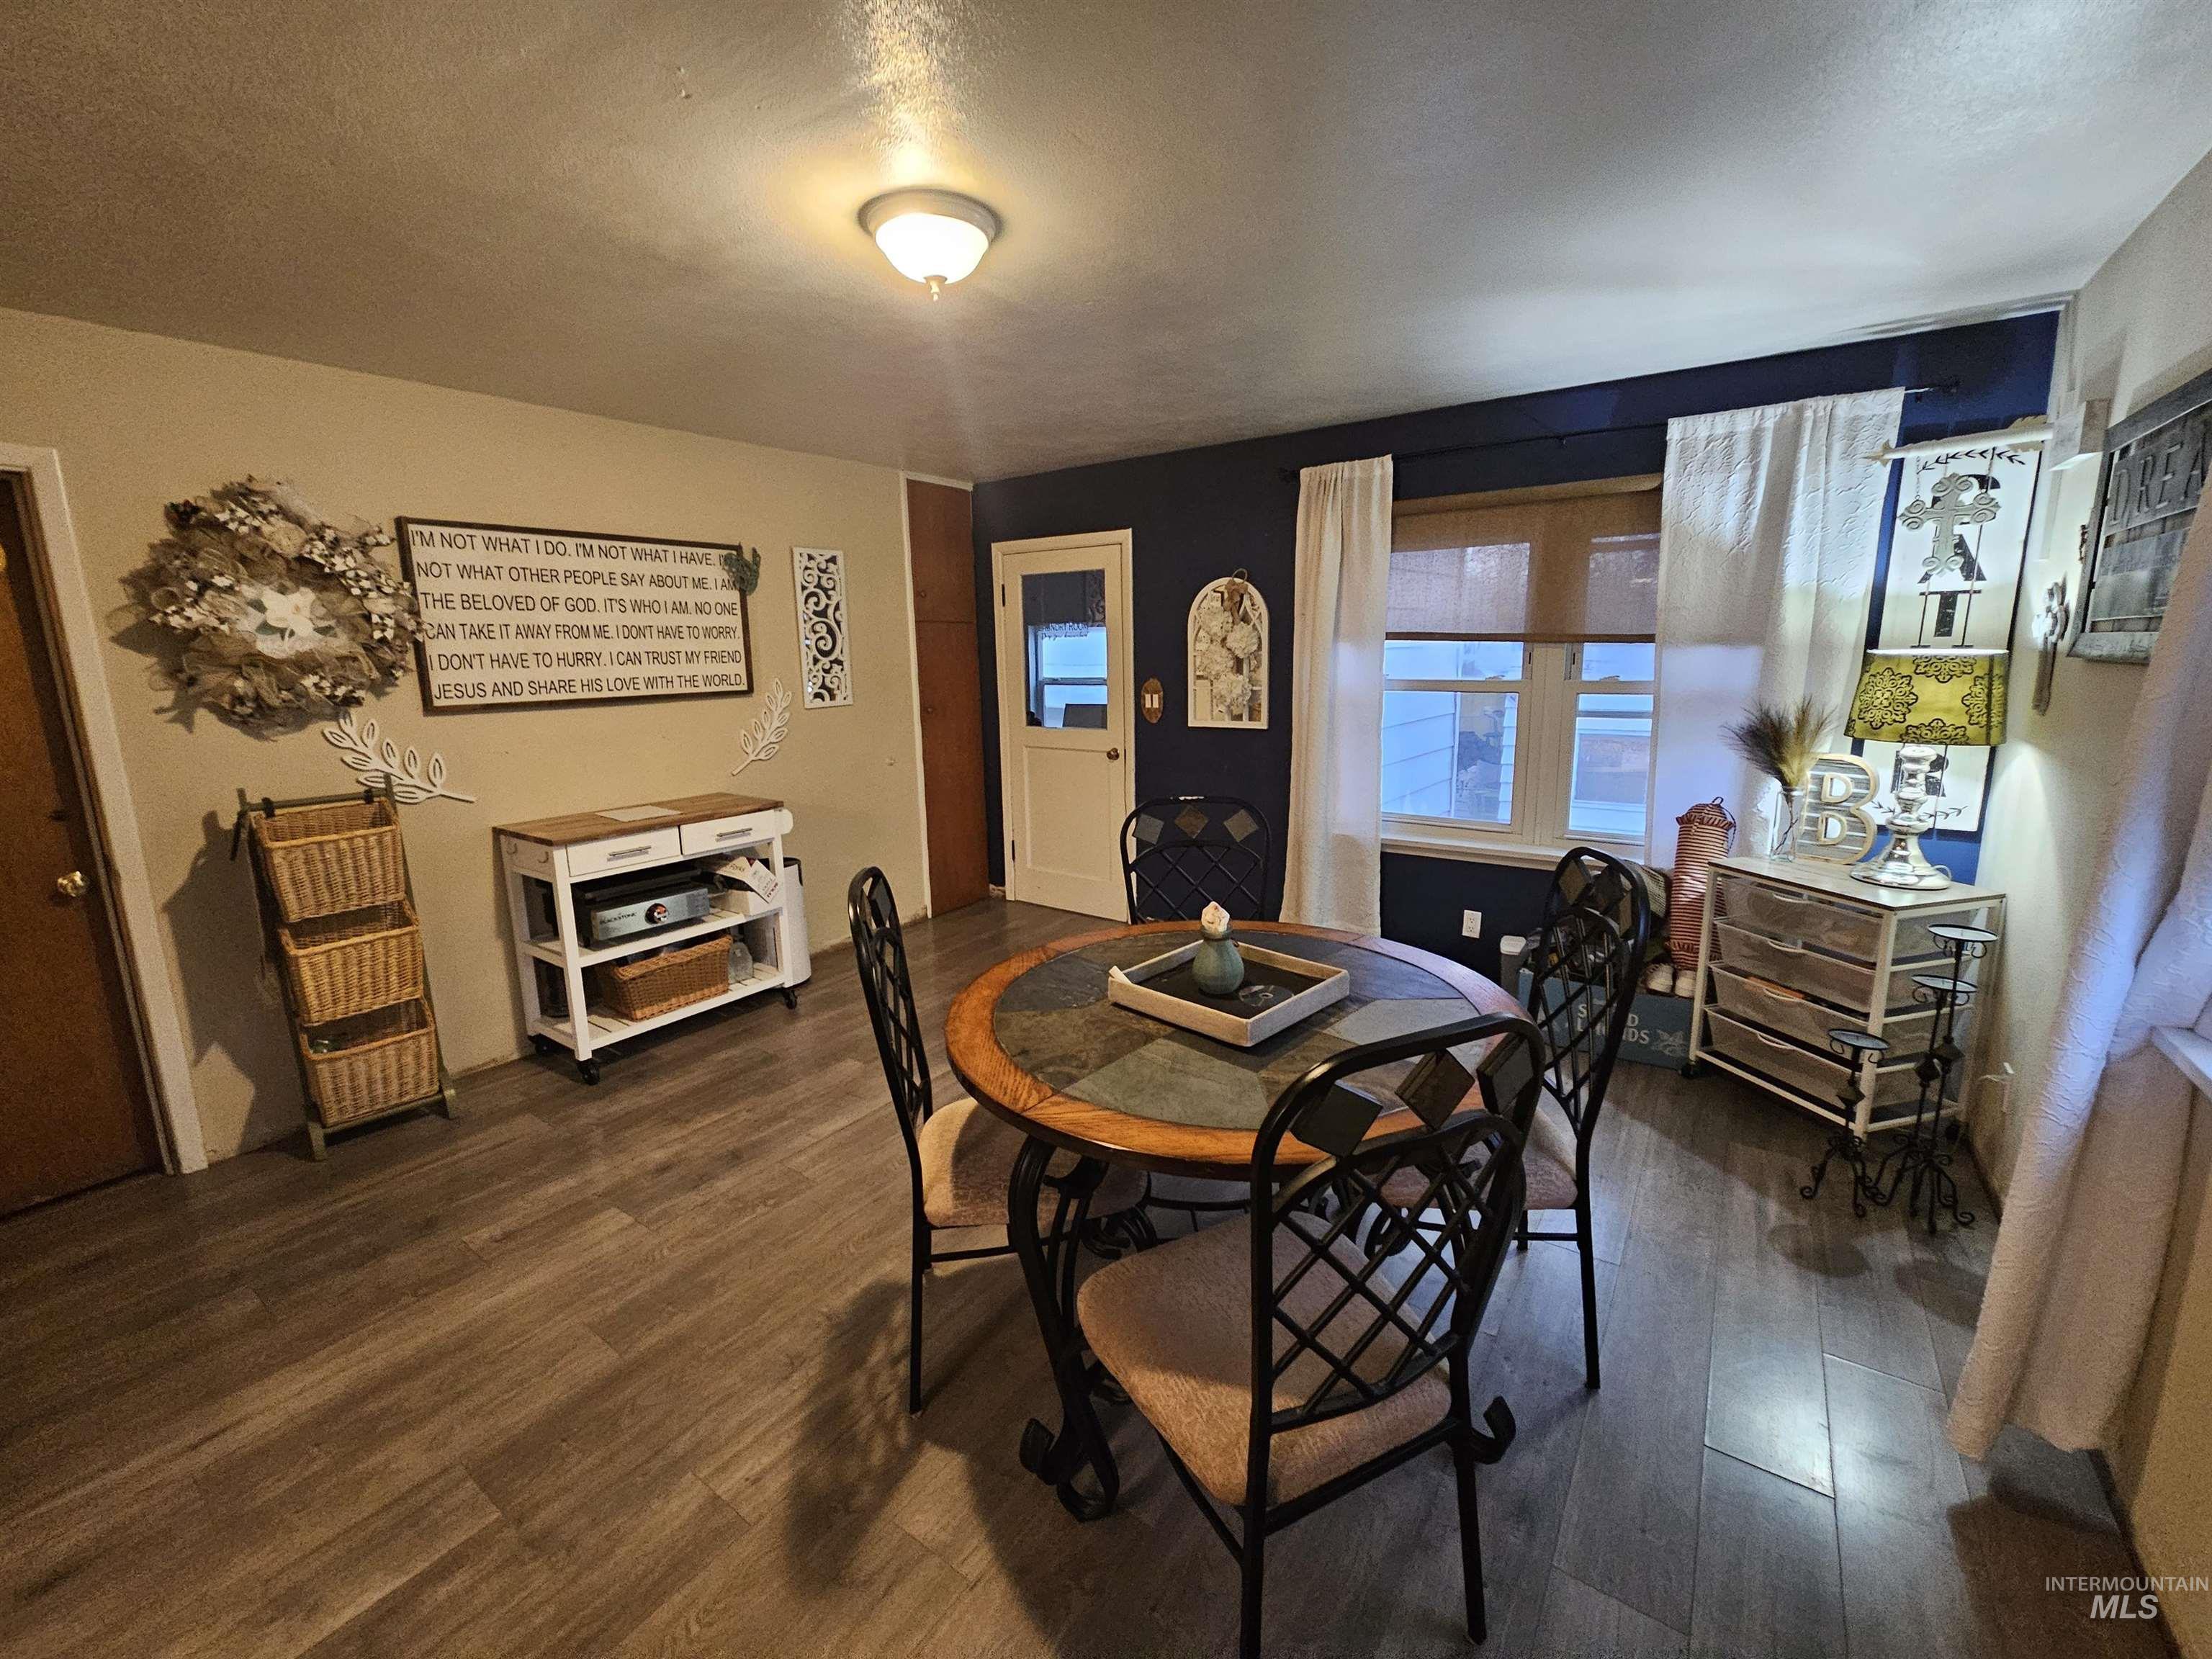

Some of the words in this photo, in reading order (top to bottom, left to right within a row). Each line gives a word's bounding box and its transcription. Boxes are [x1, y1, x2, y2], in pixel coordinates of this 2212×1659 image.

[410, 530, 435, 547] I'M
[440, 532, 477, 551] NOT
[482, 535, 531, 554] WHAT
[536, 541, 540, 555] I
[544, 541, 571, 557] DO.
[575, 542, 594, 558] I'M
[598, 545, 627, 560] NOT
[630, 547, 670, 562] WHAT
[673, 550, 677, 565] I
[680, 552, 715, 566] HAVE.
[416, 562, 451, 578] NOT
[456, 564, 503, 580] WHAT
[508, 566, 560, 584] OTHER
[564, 570, 617, 586] PEOPLE
[621, 572, 645, 587] SAY
[649, 575, 688, 589] ABOUT
[692, 577, 712, 590] ME.
[714, 578, 718, 590] I
[420, 592, 456, 611] THE
[461, 594, 536, 612] BELOVED
[540, 596, 560, 612] OF
[565, 597, 600, 613] GOD.
[603, 598, 626, 613] IT'S
[629, 599, 661, 614] WHO
[665, 601, 668, 614] I
[671, 601, 692, 615] AM.
[695, 602, 711, 616] NO
[715, 603, 737, 616] ONE
[426, 622, 456, 640] CAN
[459, 623, 496, 640] TAKE
[499, 623, 511, 640] IT
[515, 623, 551, 640] AWAY
[555, 624, 590, 640] FROM
[593, 624, 613, 640] ME.
[616, 624, 620, 640] I
[622, 624, 653, 640] DON'T
[657, 625, 684, 640] HAVE
[686, 625, 700, 640] TO
[702, 626, 740, 640] WORRY.
[428, 655, 433, 671] I
[438, 653, 485, 671] DON'T
[490, 652, 530, 670] HAVE
[534, 652, 553, 669] TO
[557, 651, 607, 668] HURRY.
[609, 652, 613, 666] I
[616, 651, 642, 666] CAN
[645, 650, 682, 665] TRUST
[685, 650, 701, 665] MY
[704, 650, 742, 665] FRIEND
[434, 682, 487, 700] JESUS
[491, 680, 523, 697] AND
[529, 679, 577, 696] SHARE
[581, 678, 603, 693] HIS
[606, 677, 640, 692] LOVE
[643, 675, 674, 690] WITH
[677, 675, 701, 688] THE
[702, 673, 745, 688] WORLD.
